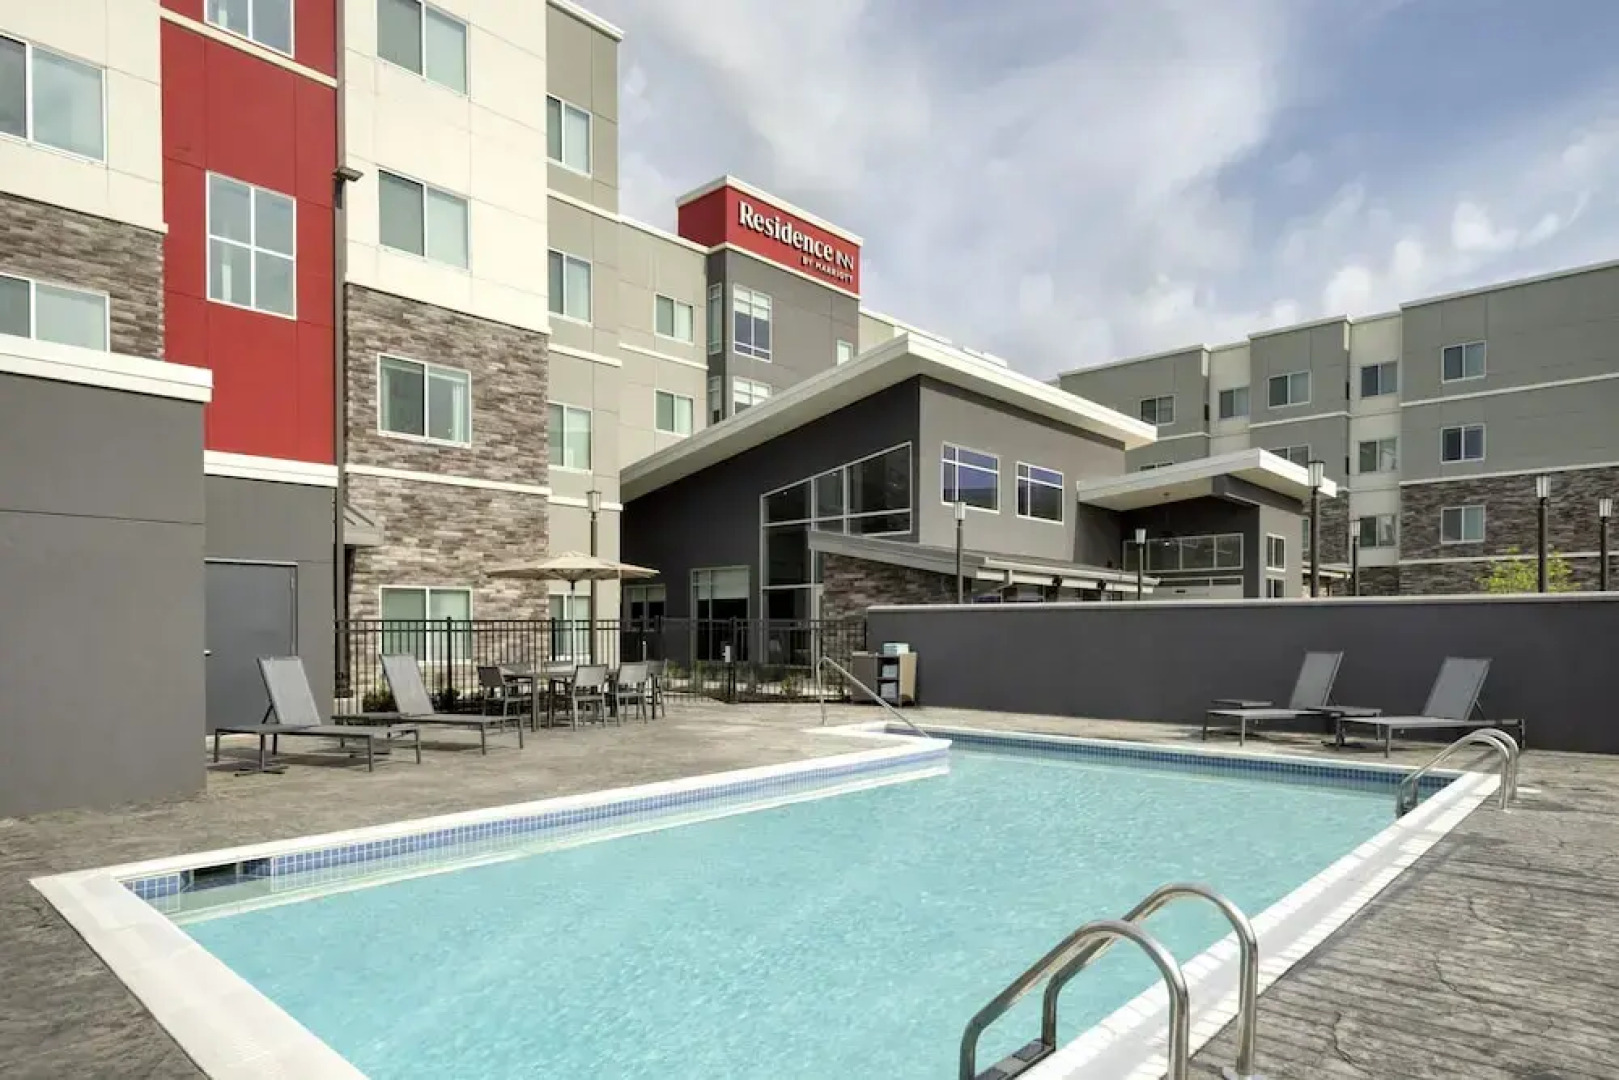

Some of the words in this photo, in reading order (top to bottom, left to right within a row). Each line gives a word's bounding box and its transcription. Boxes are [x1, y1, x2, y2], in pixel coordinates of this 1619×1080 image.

[739, 201, 833, 261] Residence
[802, 255, 812, 266] BY
[815, 261, 853, 284] MARRIOTT
